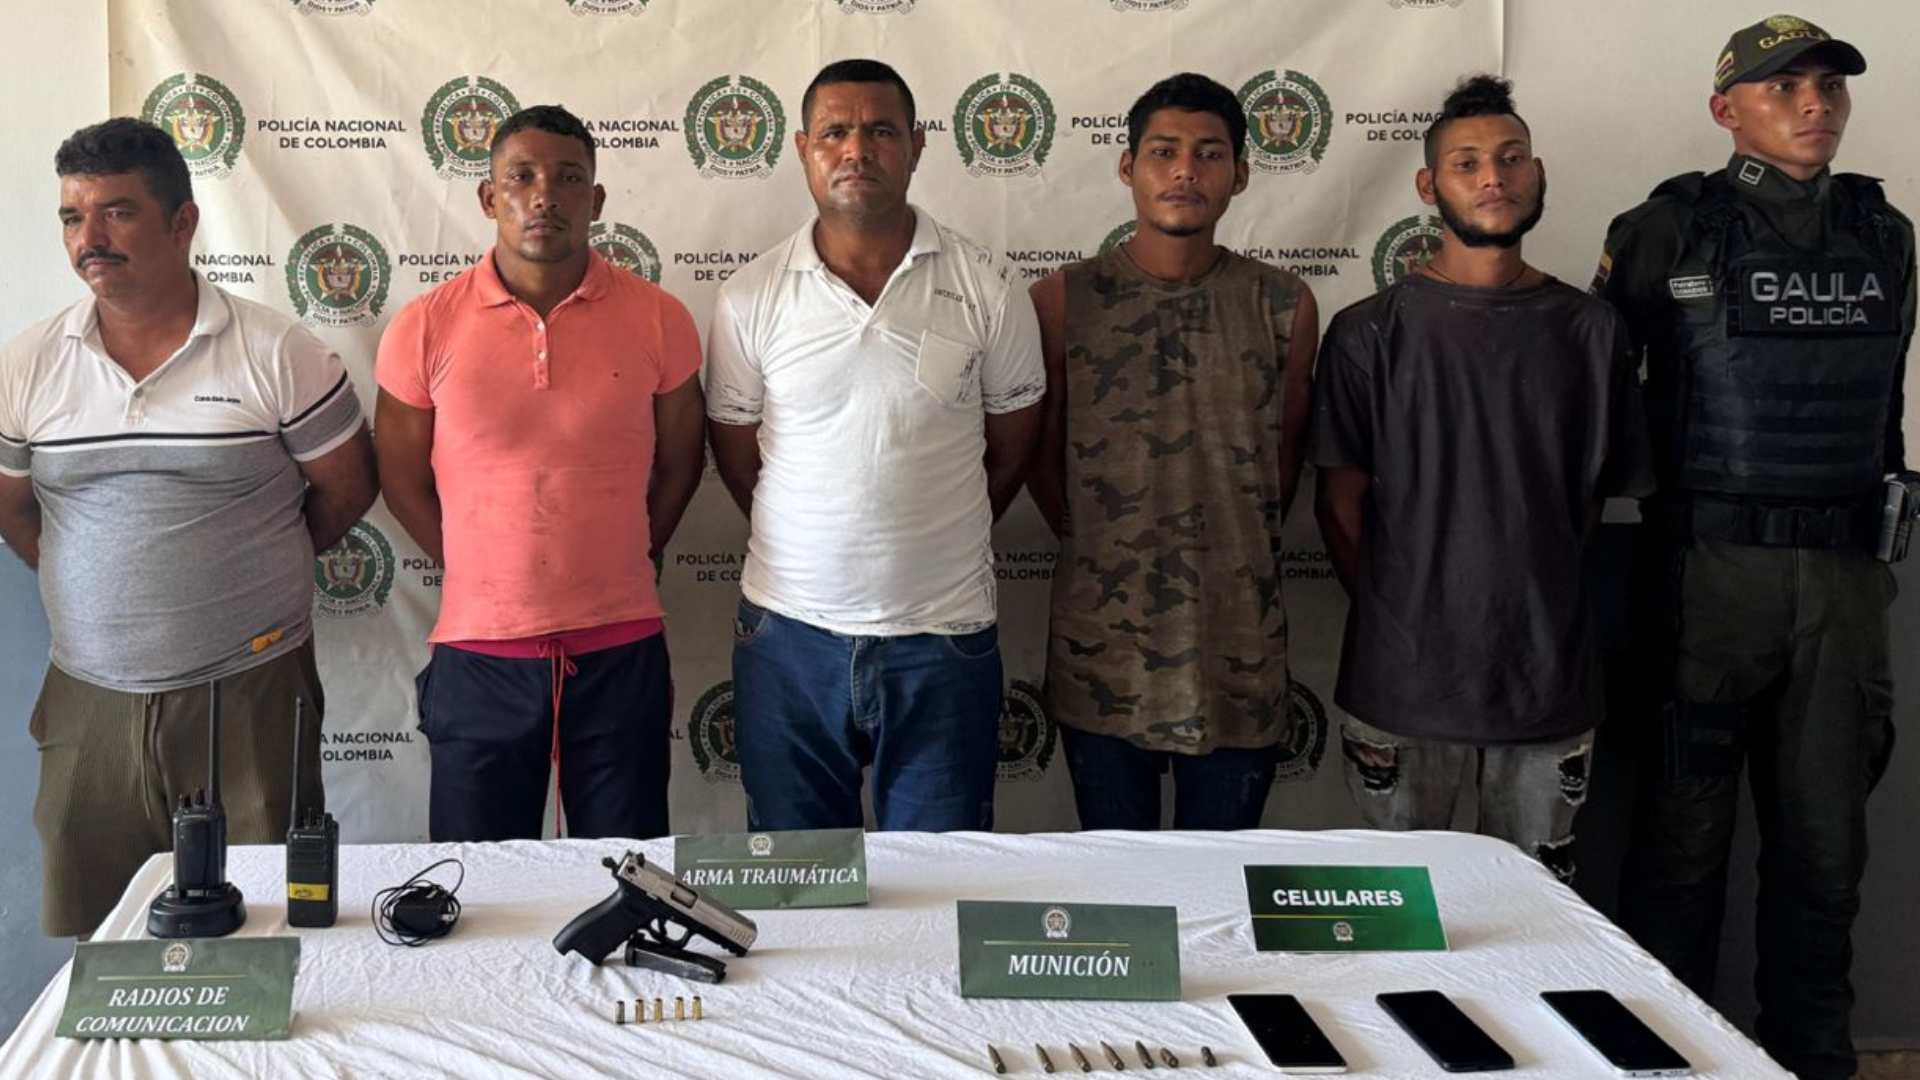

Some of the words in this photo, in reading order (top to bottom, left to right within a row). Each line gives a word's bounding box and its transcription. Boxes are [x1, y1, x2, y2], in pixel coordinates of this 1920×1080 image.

[1346, 110, 1408, 124] POLICÍA
[258, 117, 321, 132] POLICÍA
[325, 120, 407, 132] NACIONAL
[598, 120, 679, 132] NACIONAL
[1091, 133, 1111, 145] DE
[1367, 130, 1388, 141] DE
[279, 137, 300, 149] DE
[304, 137, 387, 149] COLOMBIA
[194, 254, 276, 266] NACIONAL
[399, 252, 460, 266] POLICÍA
[674, 250, 735, 265] POLICÍA
[1279, 247, 1359, 260] NACIONAL
[207, 271, 254, 283] OMBIA
[419, 271, 439, 283] DE
[694, 269, 714, 281] DE
[1751, 272, 1884, 302] GAULA
[1769, 303, 1868, 325] POLICÍA
[676, 550, 736, 565] POLICÍA
[423, 575, 442, 586] DE
[697, 570, 716, 581] DE
[333, 732, 414, 744] NACIONAL
[323, 749, 393, 761] OLOMBIA
[682, 868, 734, 886] ARMA
[740, 864, 859, 885] TRAUMÁTICA
[1272, 889, 1405, 906] CELULARES
[1008, 951, 1130, 977] MUNICIÓN
[108, 987, 194, 1007] RADIOS
[196, 987, 229, 1006] DE
[76, 1015, 250, 1033] COMUNICACION
